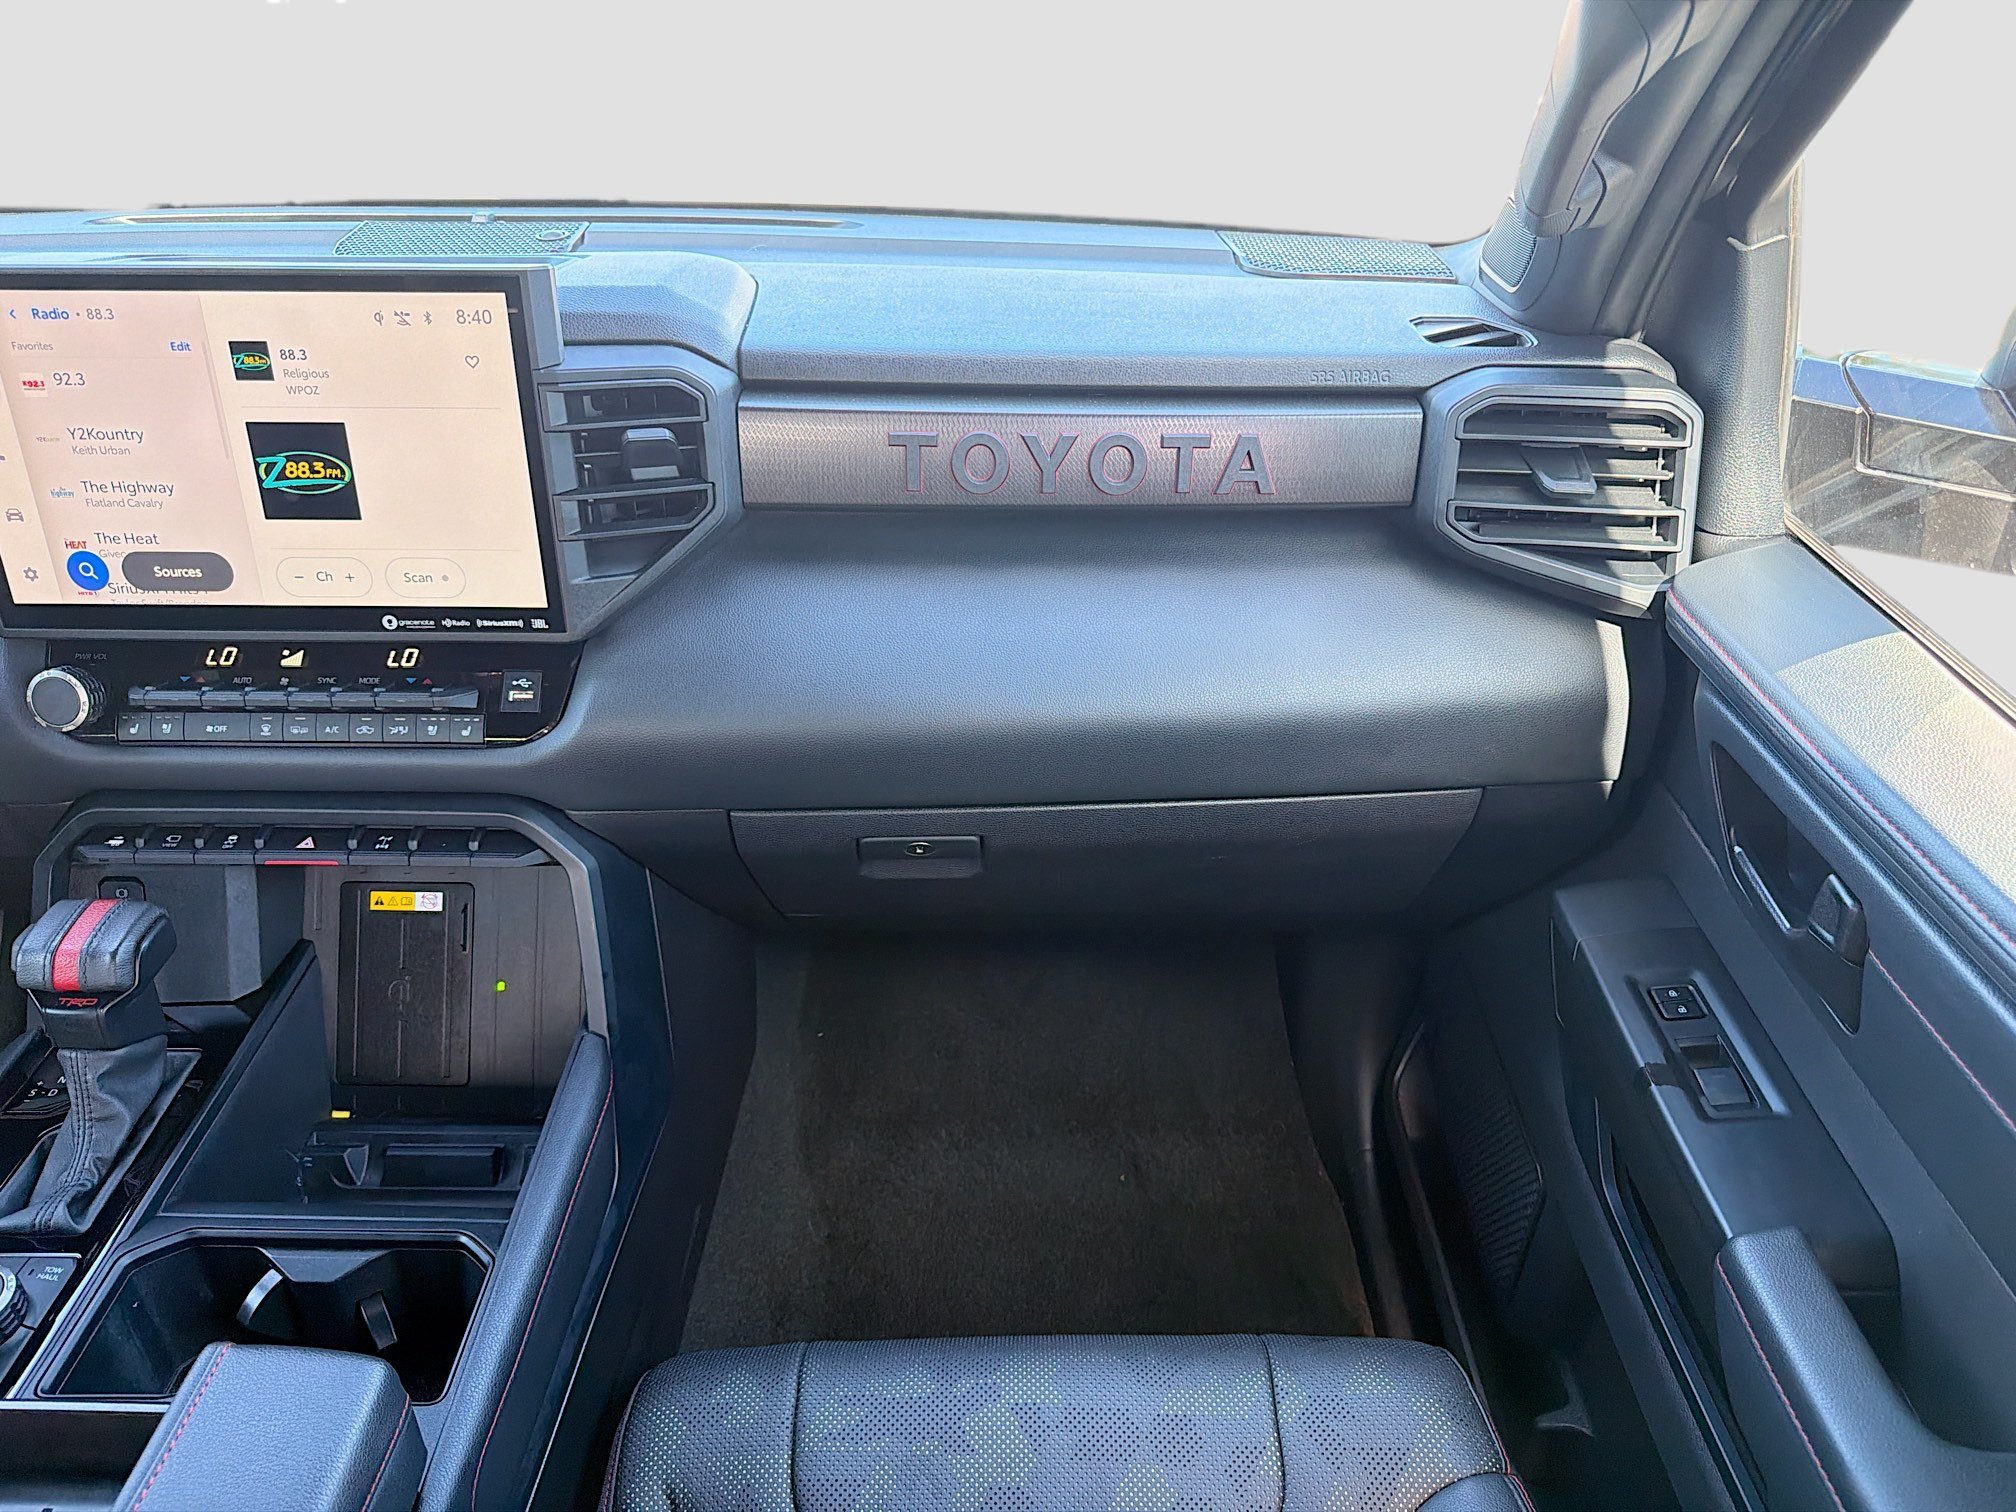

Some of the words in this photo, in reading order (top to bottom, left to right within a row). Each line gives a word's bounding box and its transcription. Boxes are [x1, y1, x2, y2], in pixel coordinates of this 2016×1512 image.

[31, 308, 70, 321] Radio
[86, 308, 115, 321] 88.3
[456, 309, 492, 325] 8:40
[11, 341, 54, 351] Favorites
[170, 341, 192, 352] Edit
[279, 349, 308, 361] 88.3
[53, 372, 86, 386] 92.3
[282, 368, 330, 380] Religious
[1309, 370, 1335, 382] SRS
[1339, 369, 1391, 383] AIRBAG
[285, 385, 320, 395] WPOZ
[66, 427, 144, 444] Y2Kountry
[72, 445, 97, 455] Keith
[99, 445, 131, 455] Urban
[888, 430, 1277, 496] TOYOTA
[80, 480, 108, 493] The
[111, 480, 174, 496] Highway
[85, 499, 126, 508] Flatland
[127, 499, 163, 509] Cavalry
[94, 532, 121, 544] The
[124, 532, 160, 544] Heat
[65, 541, 87, 549] HEAT
[154, 566, 203, 578] Sources
[316, 571, 334, 583] Ch
[403, 572, 433, 583] Scan
[398, 618, 436, 627] gracenote
[452, 619, 471, 627] Radio
[530, 618, 549, 629] JBL
[93, 652, 108, 660] VOL
[233, 676, 253, 684] AUTO
[317, 676, 337, 684] SYNC
[358, 676, 382, 684] MODE
[213, 725, 228, 733] OFF
[325, 726, 340, 734] A/C
[58, 997, 98, 1008] TRD
[57, 1075, 67, 1084] N
[44, 1266, 64, 1274] TOW
[36, 1273, 60, 1282] HAUL
